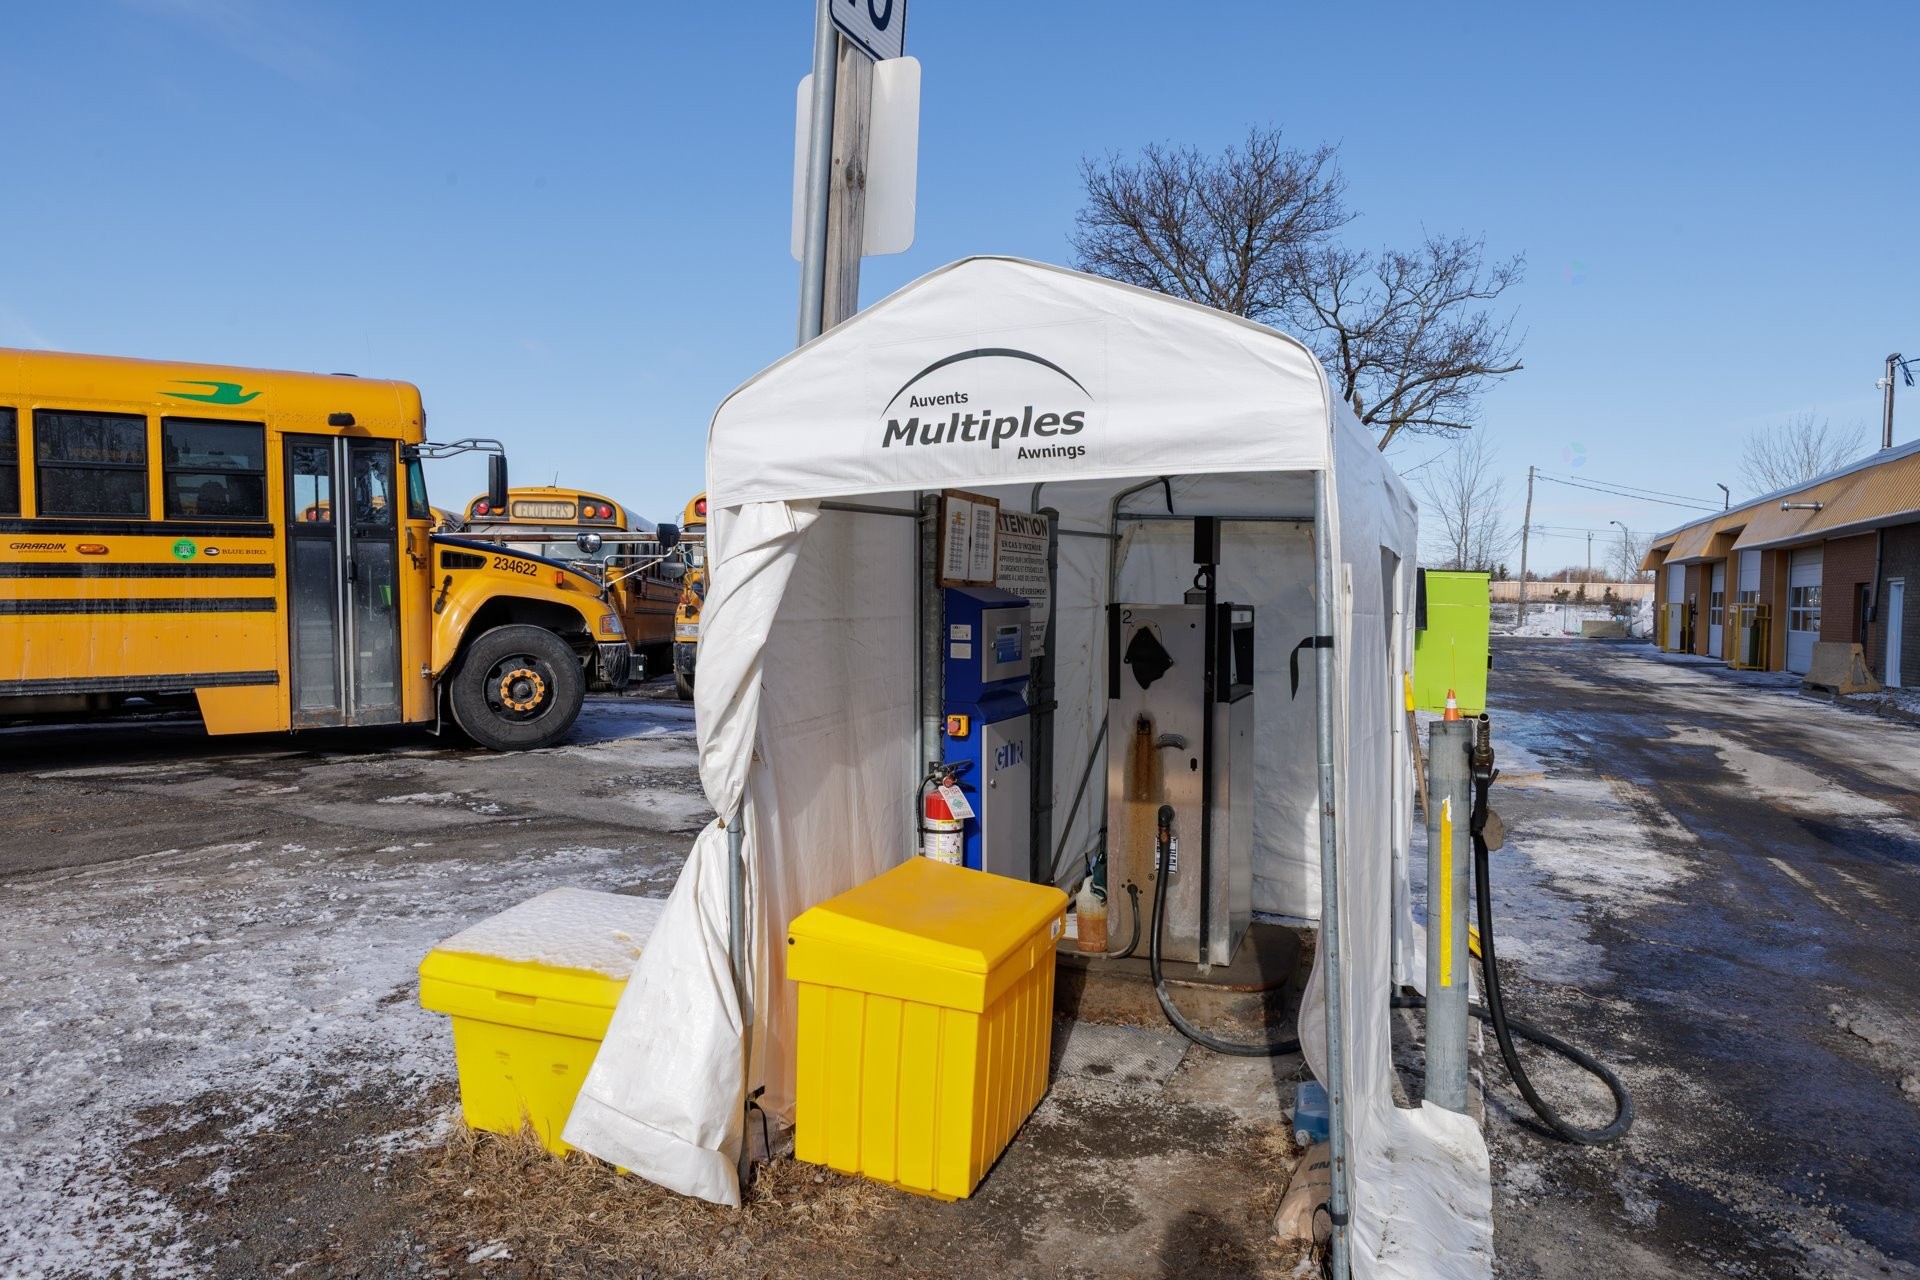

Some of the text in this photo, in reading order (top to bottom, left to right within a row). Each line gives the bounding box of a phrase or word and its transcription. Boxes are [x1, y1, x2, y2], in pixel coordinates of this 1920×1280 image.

[909, 391, 969, 408] Auvents
[882, 406, 1085, 449] Multiples
[1017, 444, 1086, 460] Awnings
[174, 546, 196, 554] PROPANE
[493, 556, 538, 577] 234622
[1122, 609, 1132, 624] 2
